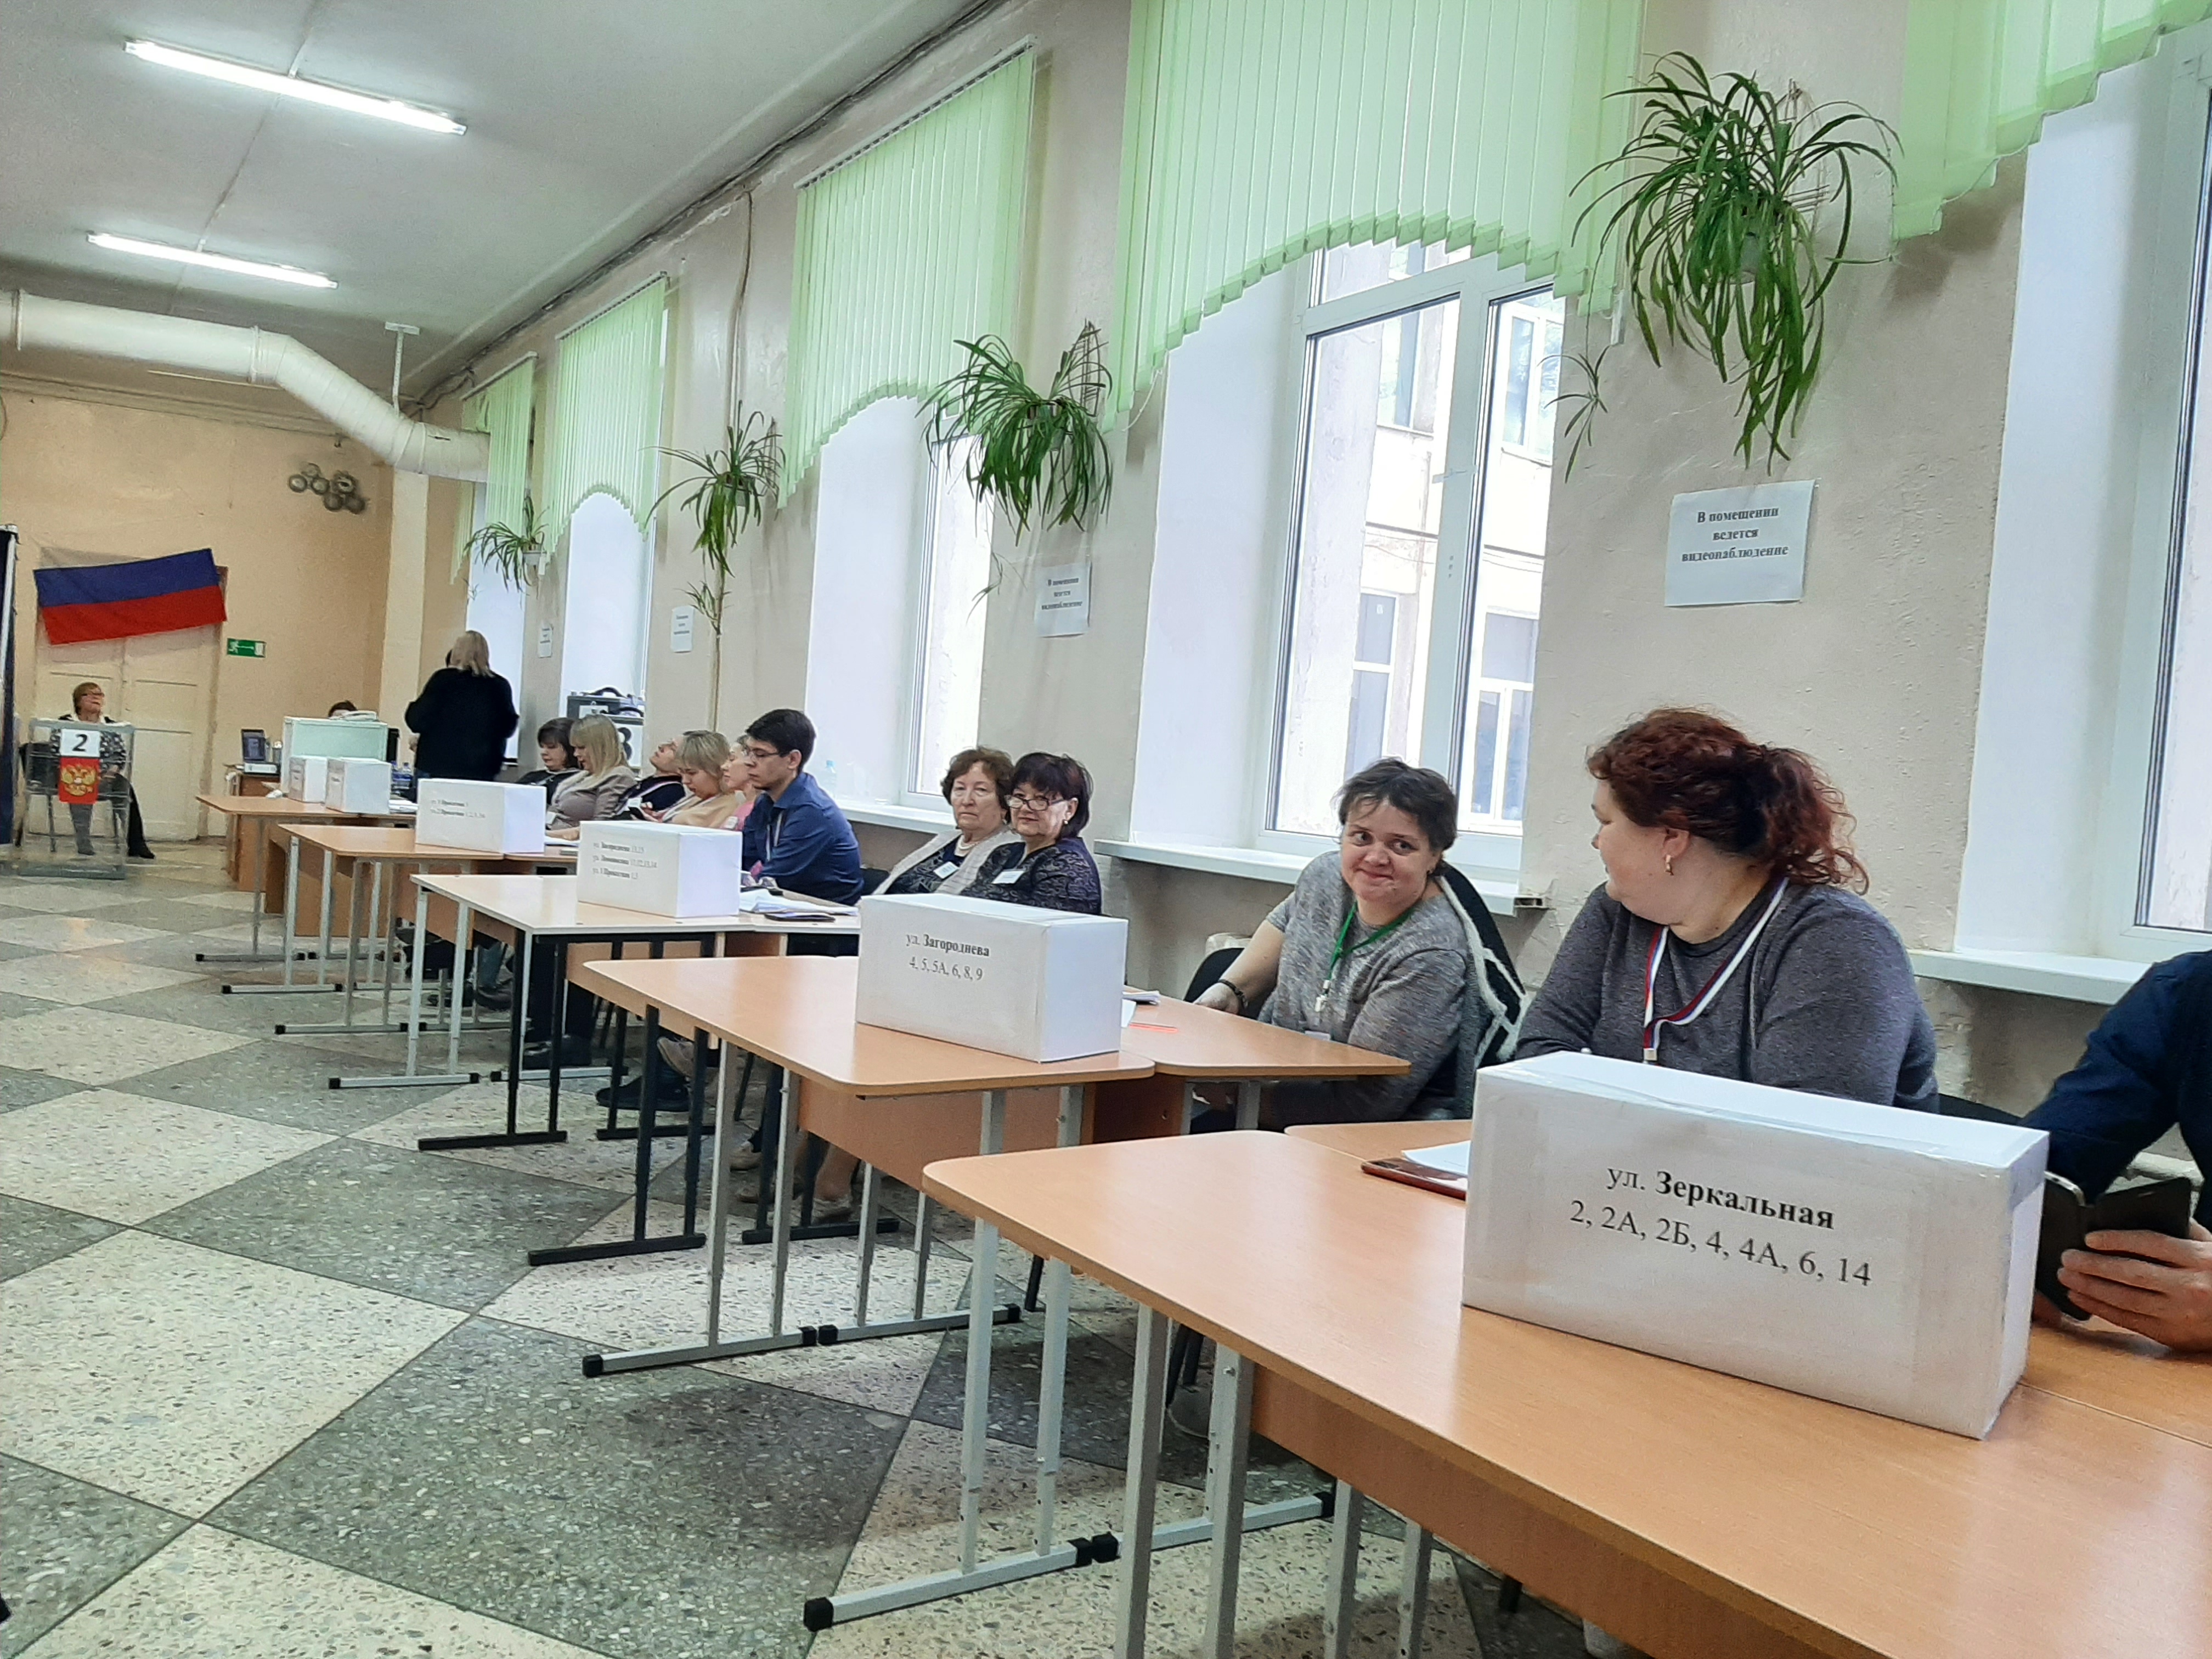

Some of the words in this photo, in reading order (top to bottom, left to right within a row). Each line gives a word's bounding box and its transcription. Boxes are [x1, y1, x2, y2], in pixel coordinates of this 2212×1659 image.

[1697, 512, 1706, 523] В
[1709, 508, 1779, 522] помещении
[1713, 529, 1759, 540] ведется
[1682, 546, 1788, 562] видеонаблюдение
[72, 733, 88, 752] 2
[906, 934, 920, 946] ул.
[923, 934, 990, 956] Загороднева
[952, 964, 961, 979] 6,
[963, 966, 973, 981] 8,
[976, 968, 983, 980] 9
[1607, 1167, 1645, 1190] ул.
[1655, 1171, 1835, 1230] Зеркальная
[1570, 1200, 1592, 1229] 2,
[1601, 1206, 1646, 1240] 2А,
[1656, 1217, 1697, 1252] 2Б,
[1705, 1231, 1729, 1260] 4,
[1739, 1238, 1788, 1273] 4А,
[1799, 1250, 1824, 1281] 6,
[1838, 1257, 1872, 1287] 14
